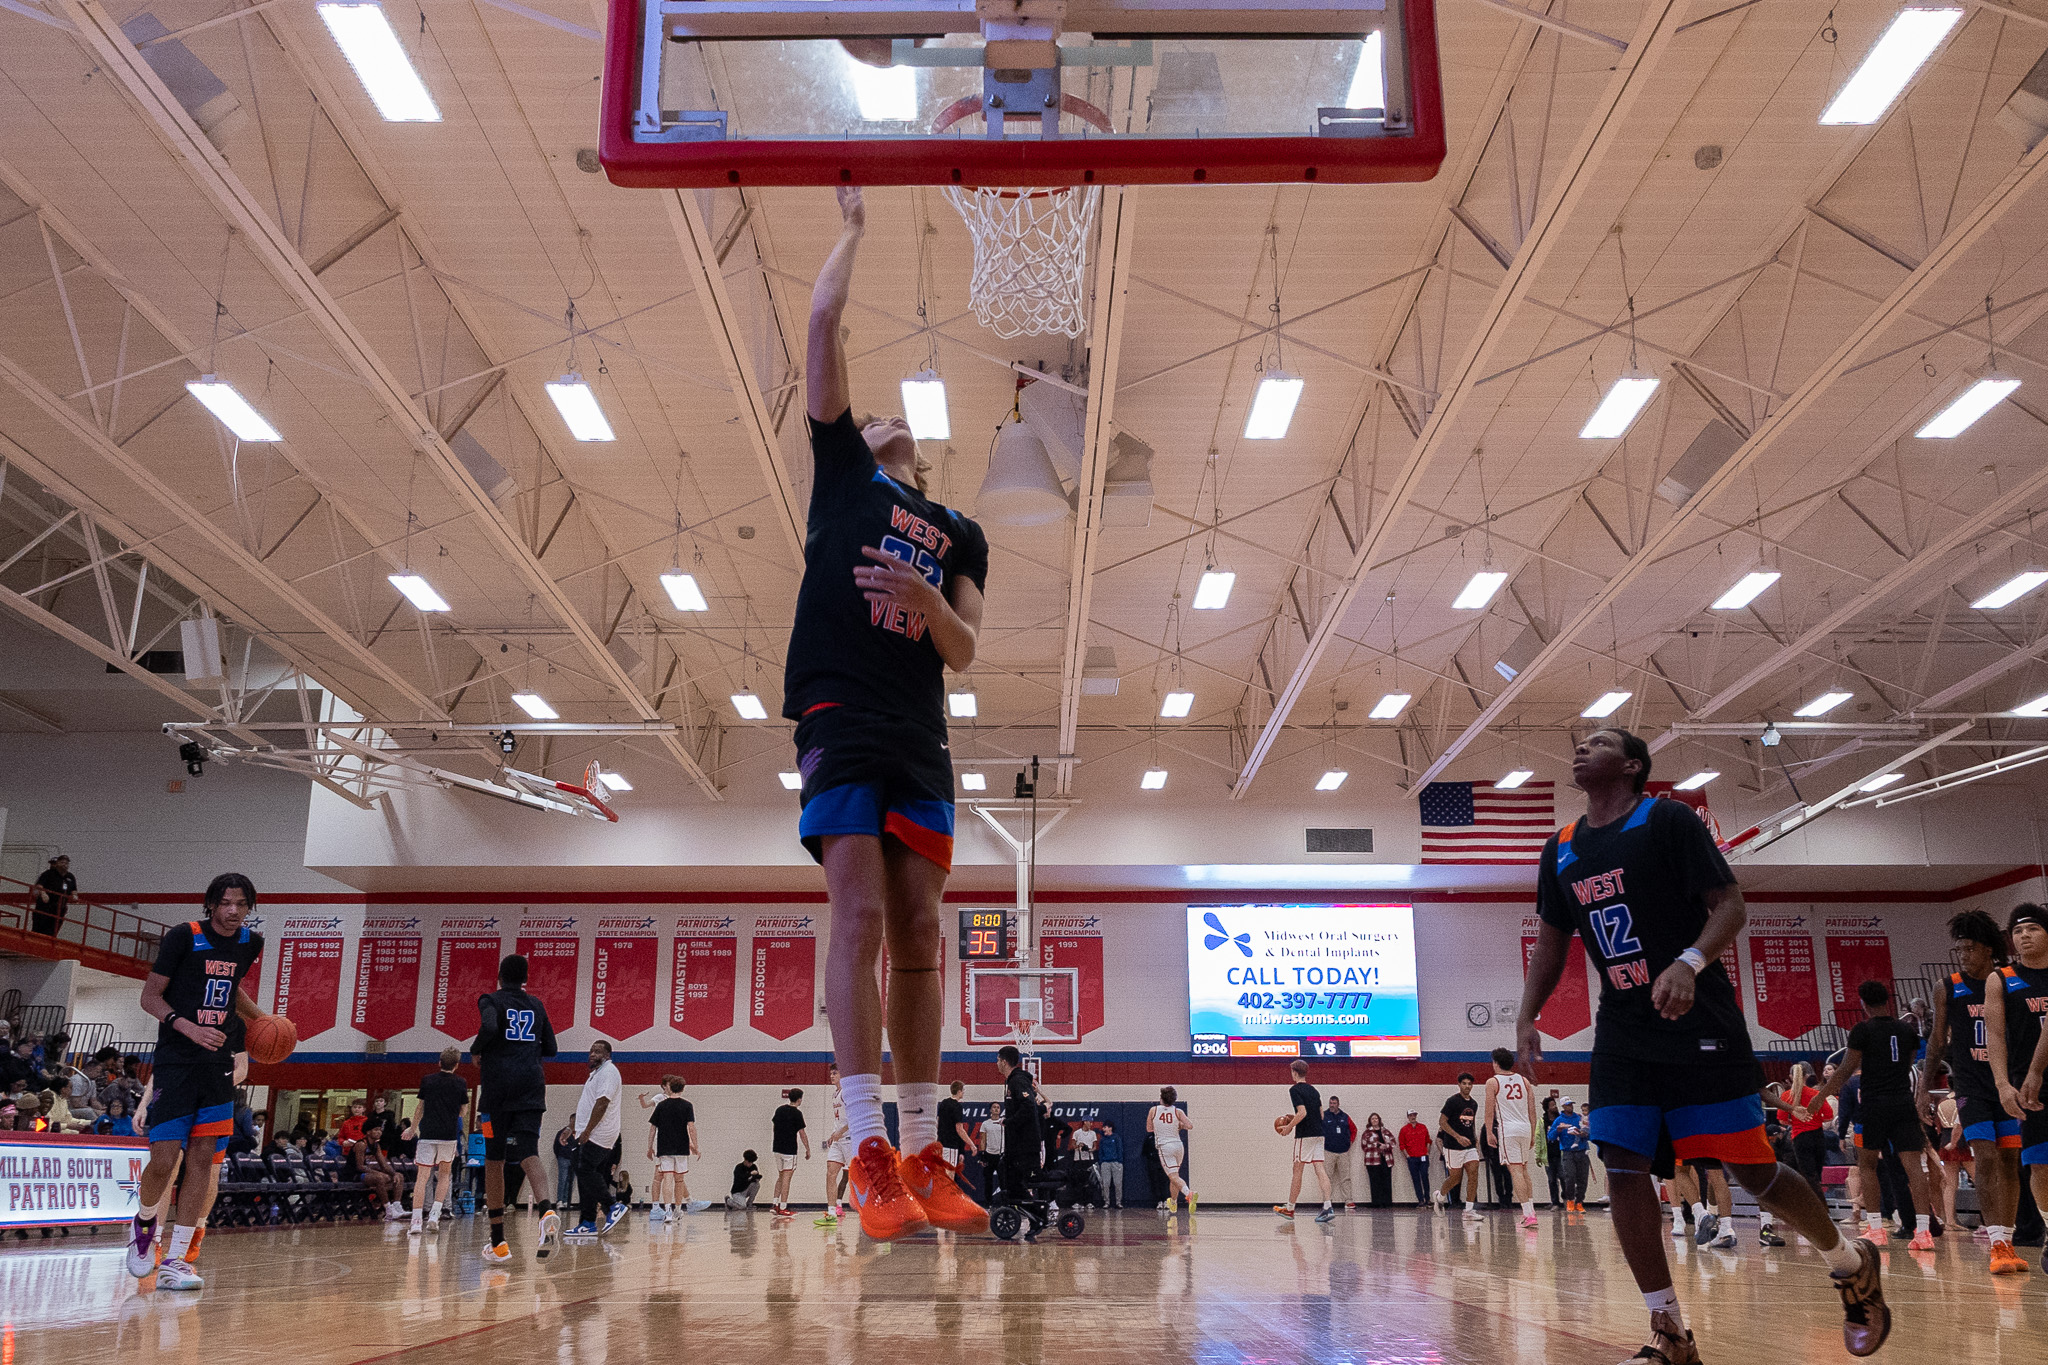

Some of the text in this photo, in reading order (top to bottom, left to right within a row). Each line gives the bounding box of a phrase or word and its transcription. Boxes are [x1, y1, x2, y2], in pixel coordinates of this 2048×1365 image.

[891, 504, 952, 560] WEST
[870, 600, 928, 642] VIEW
[1572, 868, 1624, 906] WEST
[284, 920, 328, 928] PATRIOTS
[362, 920, 406, 928] PATRIOTS
[441, 920, 484, 928] PATRIOTS
[519, 920, 563, 928] PATRIOTS
[598, 920, 641, 928] PATRIOTS
[676, 920, 719, 928] PATRIOTS
[755, 920, 799, 928] PATRIOTS
[973, 914, 1000, 926] 8:00
[1042, 919, 1085, 927] PATRIOTS
[1750, 919, 1792, 927] PATRIOTS
[1826, 919, 1868, 927] PATRIOTS
[1264, 930, 1399, 943] Midwest Oral Surgery
[1590, 904, 1642, 958] 12
[969, 930, 997, 954] 35
[1265, 948, 1380, 959] & Dental Implants
[205, 960, 237, 977] WEST
[1227, 967, 1379, 985] CALL TODAY!
[278, 941, 294, 1017] IRLS BASKETBALL
[356, 943, 372, 1022] BOYS BASKETBALL
[436, 941, 452, 1025] BOYS CROSS COUNTRY
[595, 948, 608, 1017] GIRLS GOLF
[674, 943, 687, 1022] GYMNASTICS
[754, 948, 766, 1016] BOYS SOCCER
[1044, 944, 1054, 1019] BOYS TACK
[1754, 961, 1768, 1002] CHEER
[1831, 961, 1845, 1002] DANCE
[203, 979, 232, 1008] 13
[1238, 992, 1372, 1009] 402-397-7777
[1967, 1004, 1985, 1017] WE
[2025, 996, 2048, 1012] WE
[197, 1010, 228, 1025] VIEW
[506, 1009, 535, 1041] 32
[1242, 1013, 1369, 1024] midwestoms.com
[1193, 1043, 1228, 1054] 03:06
[1314, 1043, 1336, 1055] VS
[1890, 1036, 1899, 1062] 1
[1970, 1048, 1989, 1061] VIE
[1505, 1083, 1523, 1100] 23
[1054, 1108, 1100, 1117] OUTH
[1159, 1112, 1172, 1124] 40
[68, 1158, 113, 1179] SOUTH
[8, 1182, 100, 1211] PATRIOTS
